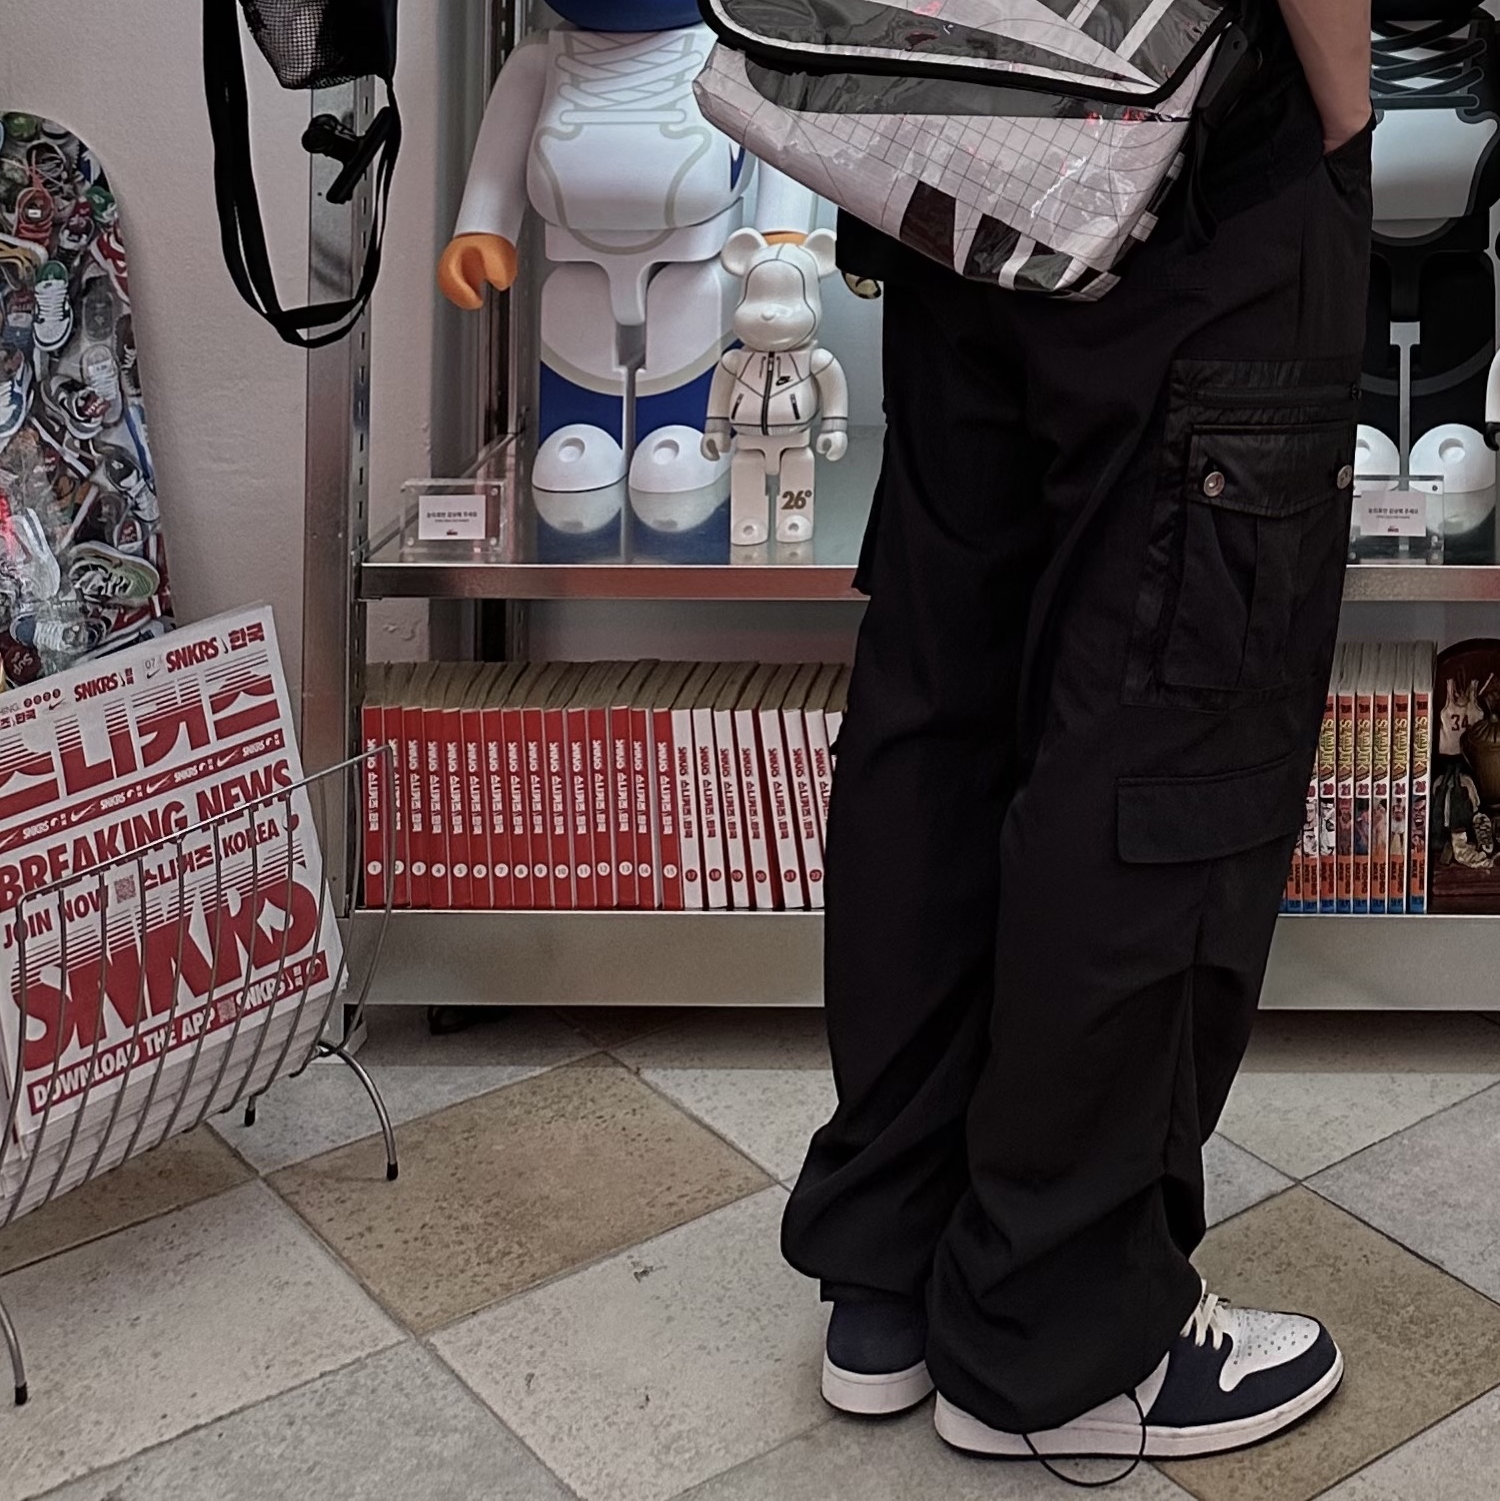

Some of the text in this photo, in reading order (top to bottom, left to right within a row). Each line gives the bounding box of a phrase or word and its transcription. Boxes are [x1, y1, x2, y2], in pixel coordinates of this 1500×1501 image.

[73, 671, 118, 702] SNKRS
[166, 621, 266, 672] SNKRS 한국
[0, 667, 281, 821] 스니커즈
[1451, 714, 1469, 731] 34
[0, 759, 295, 913] BREAKING NEWS
[3, 909, 53, 949] JOIN
[224, 818, 280, 858] KOREA
[11, 849, 319, 1072] SNKRS
[32, 1044, 141, 1108] DOWNLOAD
[143, 1022, 177, 1056] THE
[180, 1001, 216, 1039] APP
